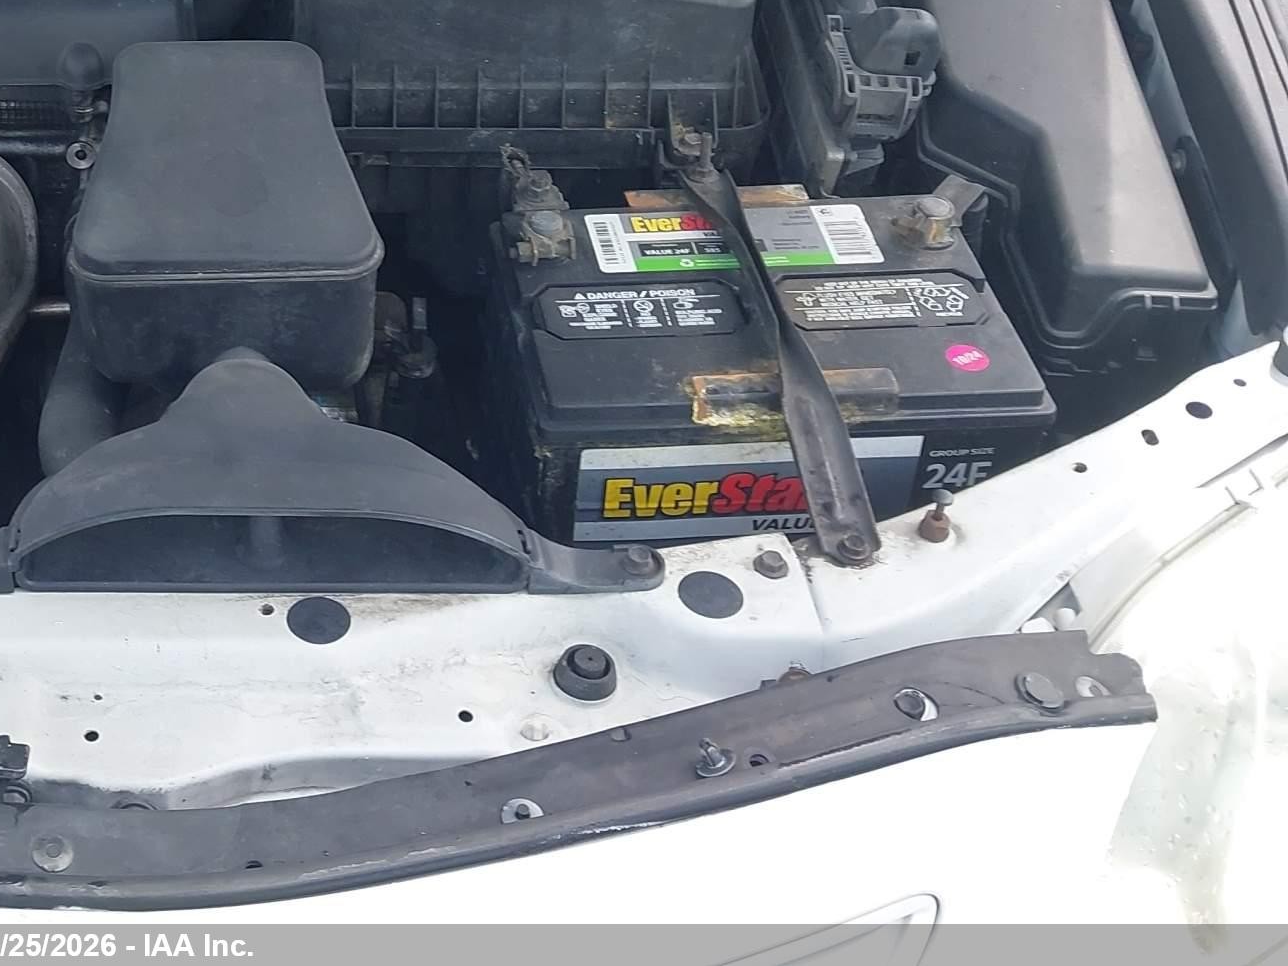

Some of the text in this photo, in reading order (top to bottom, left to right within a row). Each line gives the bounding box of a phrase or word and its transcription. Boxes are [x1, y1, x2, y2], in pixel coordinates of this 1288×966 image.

[587, 291, 638, 300] DANGER
[649, 288, 696, 298] POISON
[928, 446, 997, 458] GROUP SIZE
[921, 460, 993, 489] 24F
